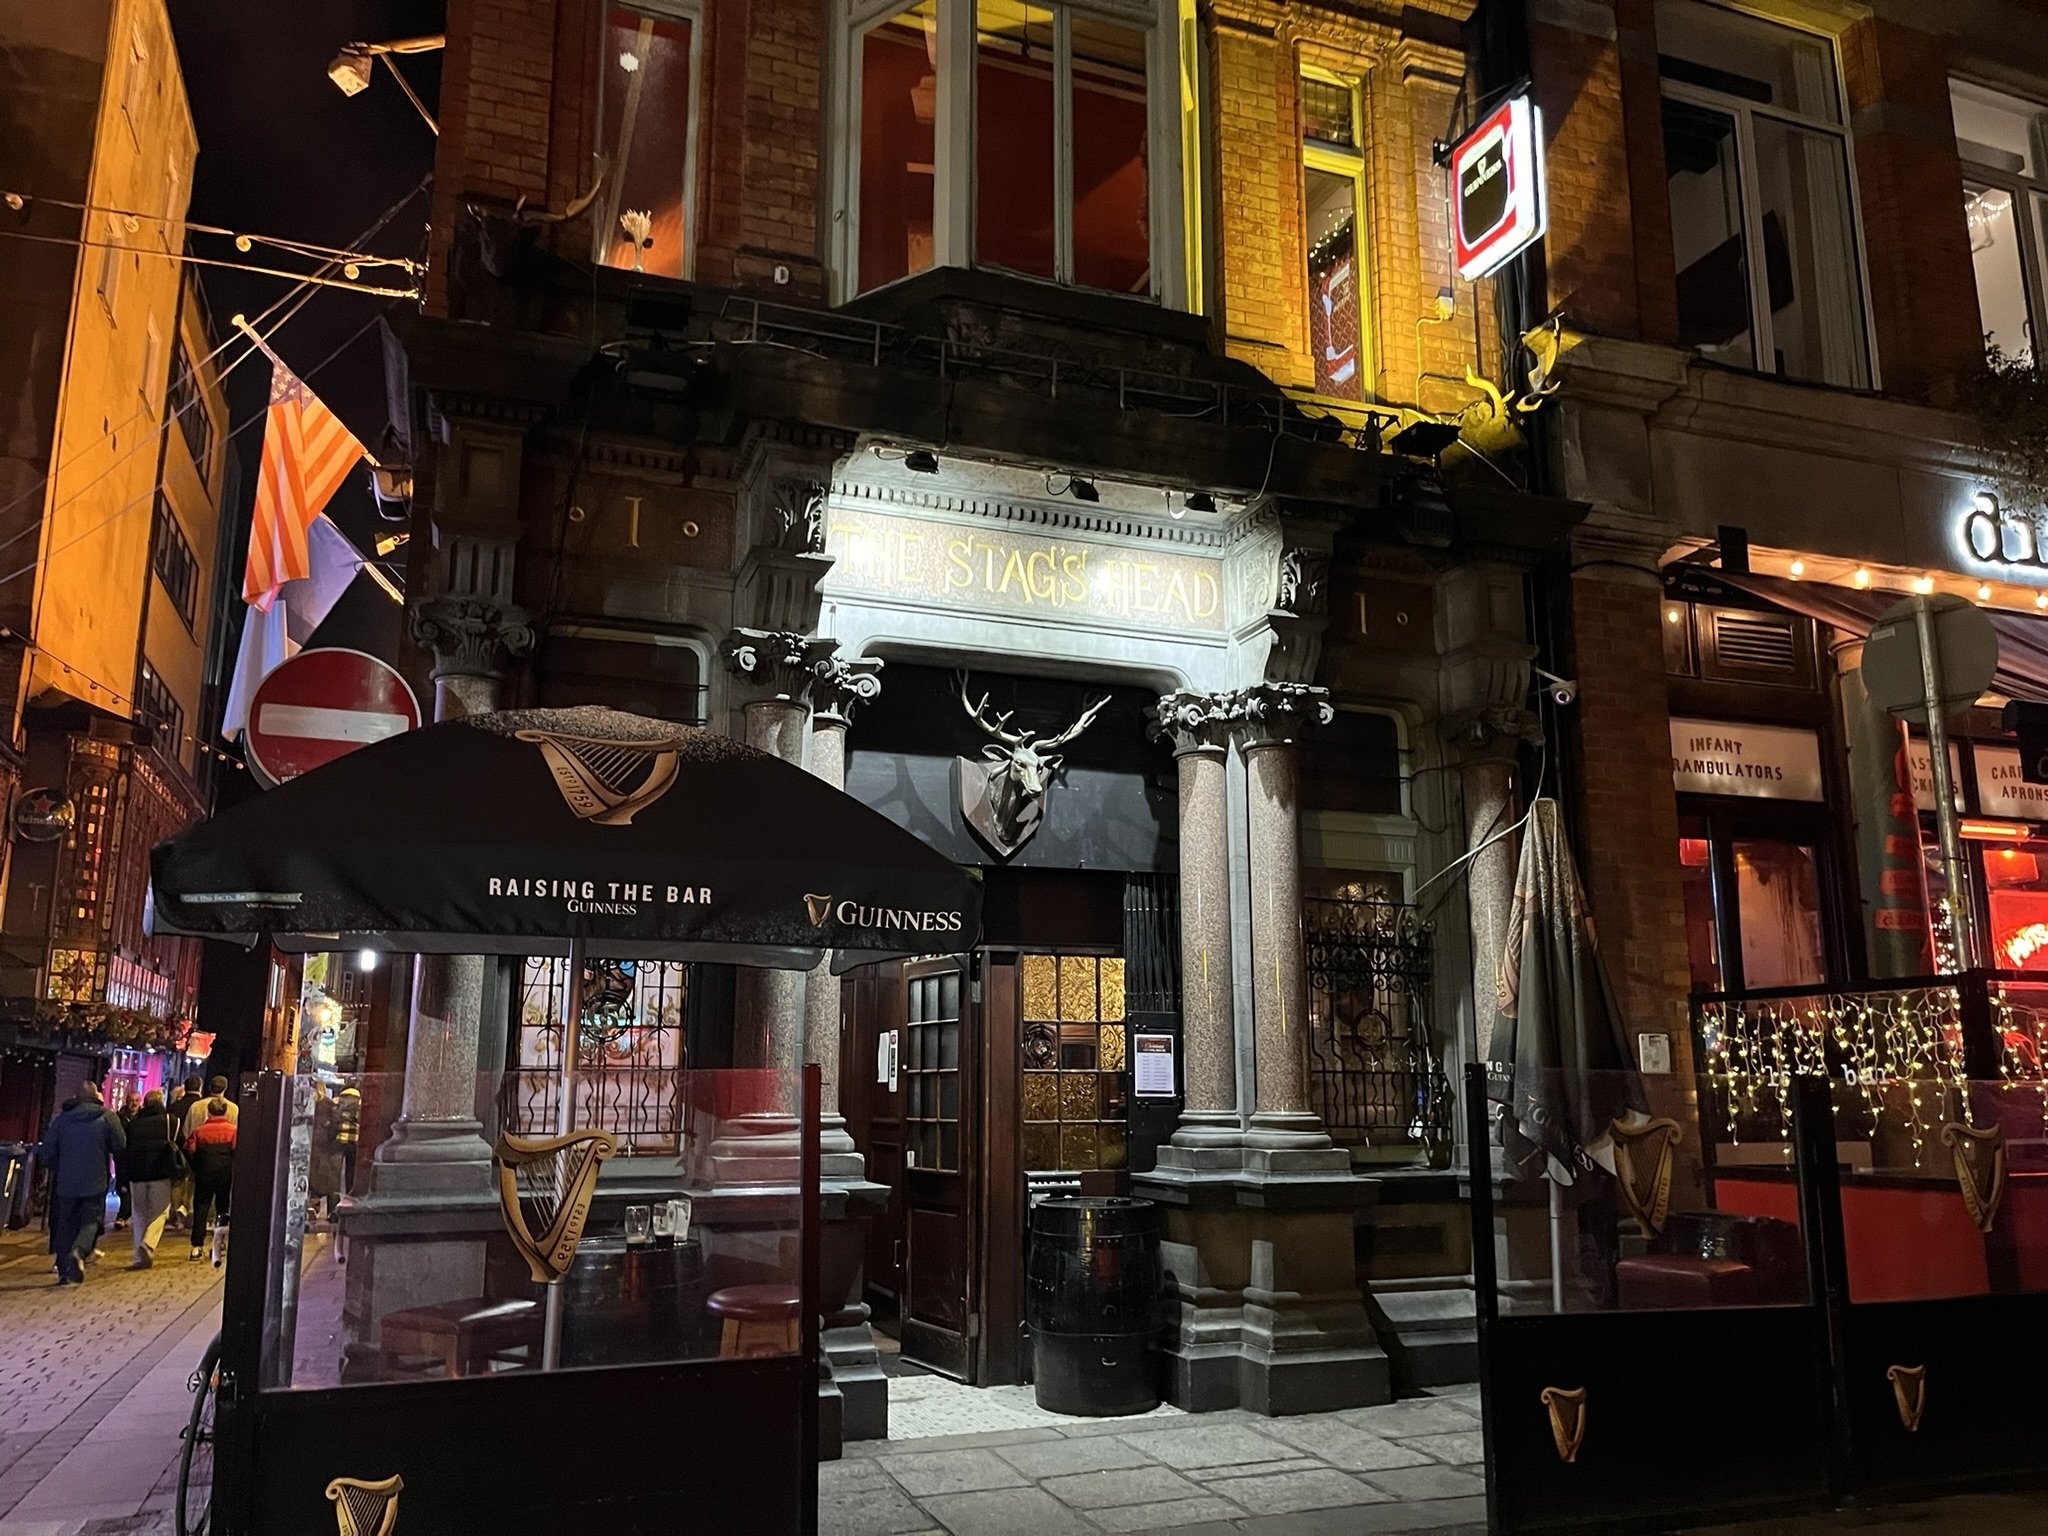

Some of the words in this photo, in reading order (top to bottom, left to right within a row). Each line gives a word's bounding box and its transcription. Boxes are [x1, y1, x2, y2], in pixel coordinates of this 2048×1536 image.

[829, 523, 924, 586] THE
[942, 534, 1088, 607] STAG'S
[1104, 559, 1218, 623] HEAD
[1690, 737, 1743, 755] INFANT
[1673, 758, 1783, 780] RAMBULATORS
[566, 785, 594, 808] 1759
[489, 877, 595, 899] RAISING
[608, 882, 654, 902] THE
[666, 885, 712, 904] BAR
[567, 899, 637, 916] GUINNESS
[836, 900, 962, 931] GUINNESS
